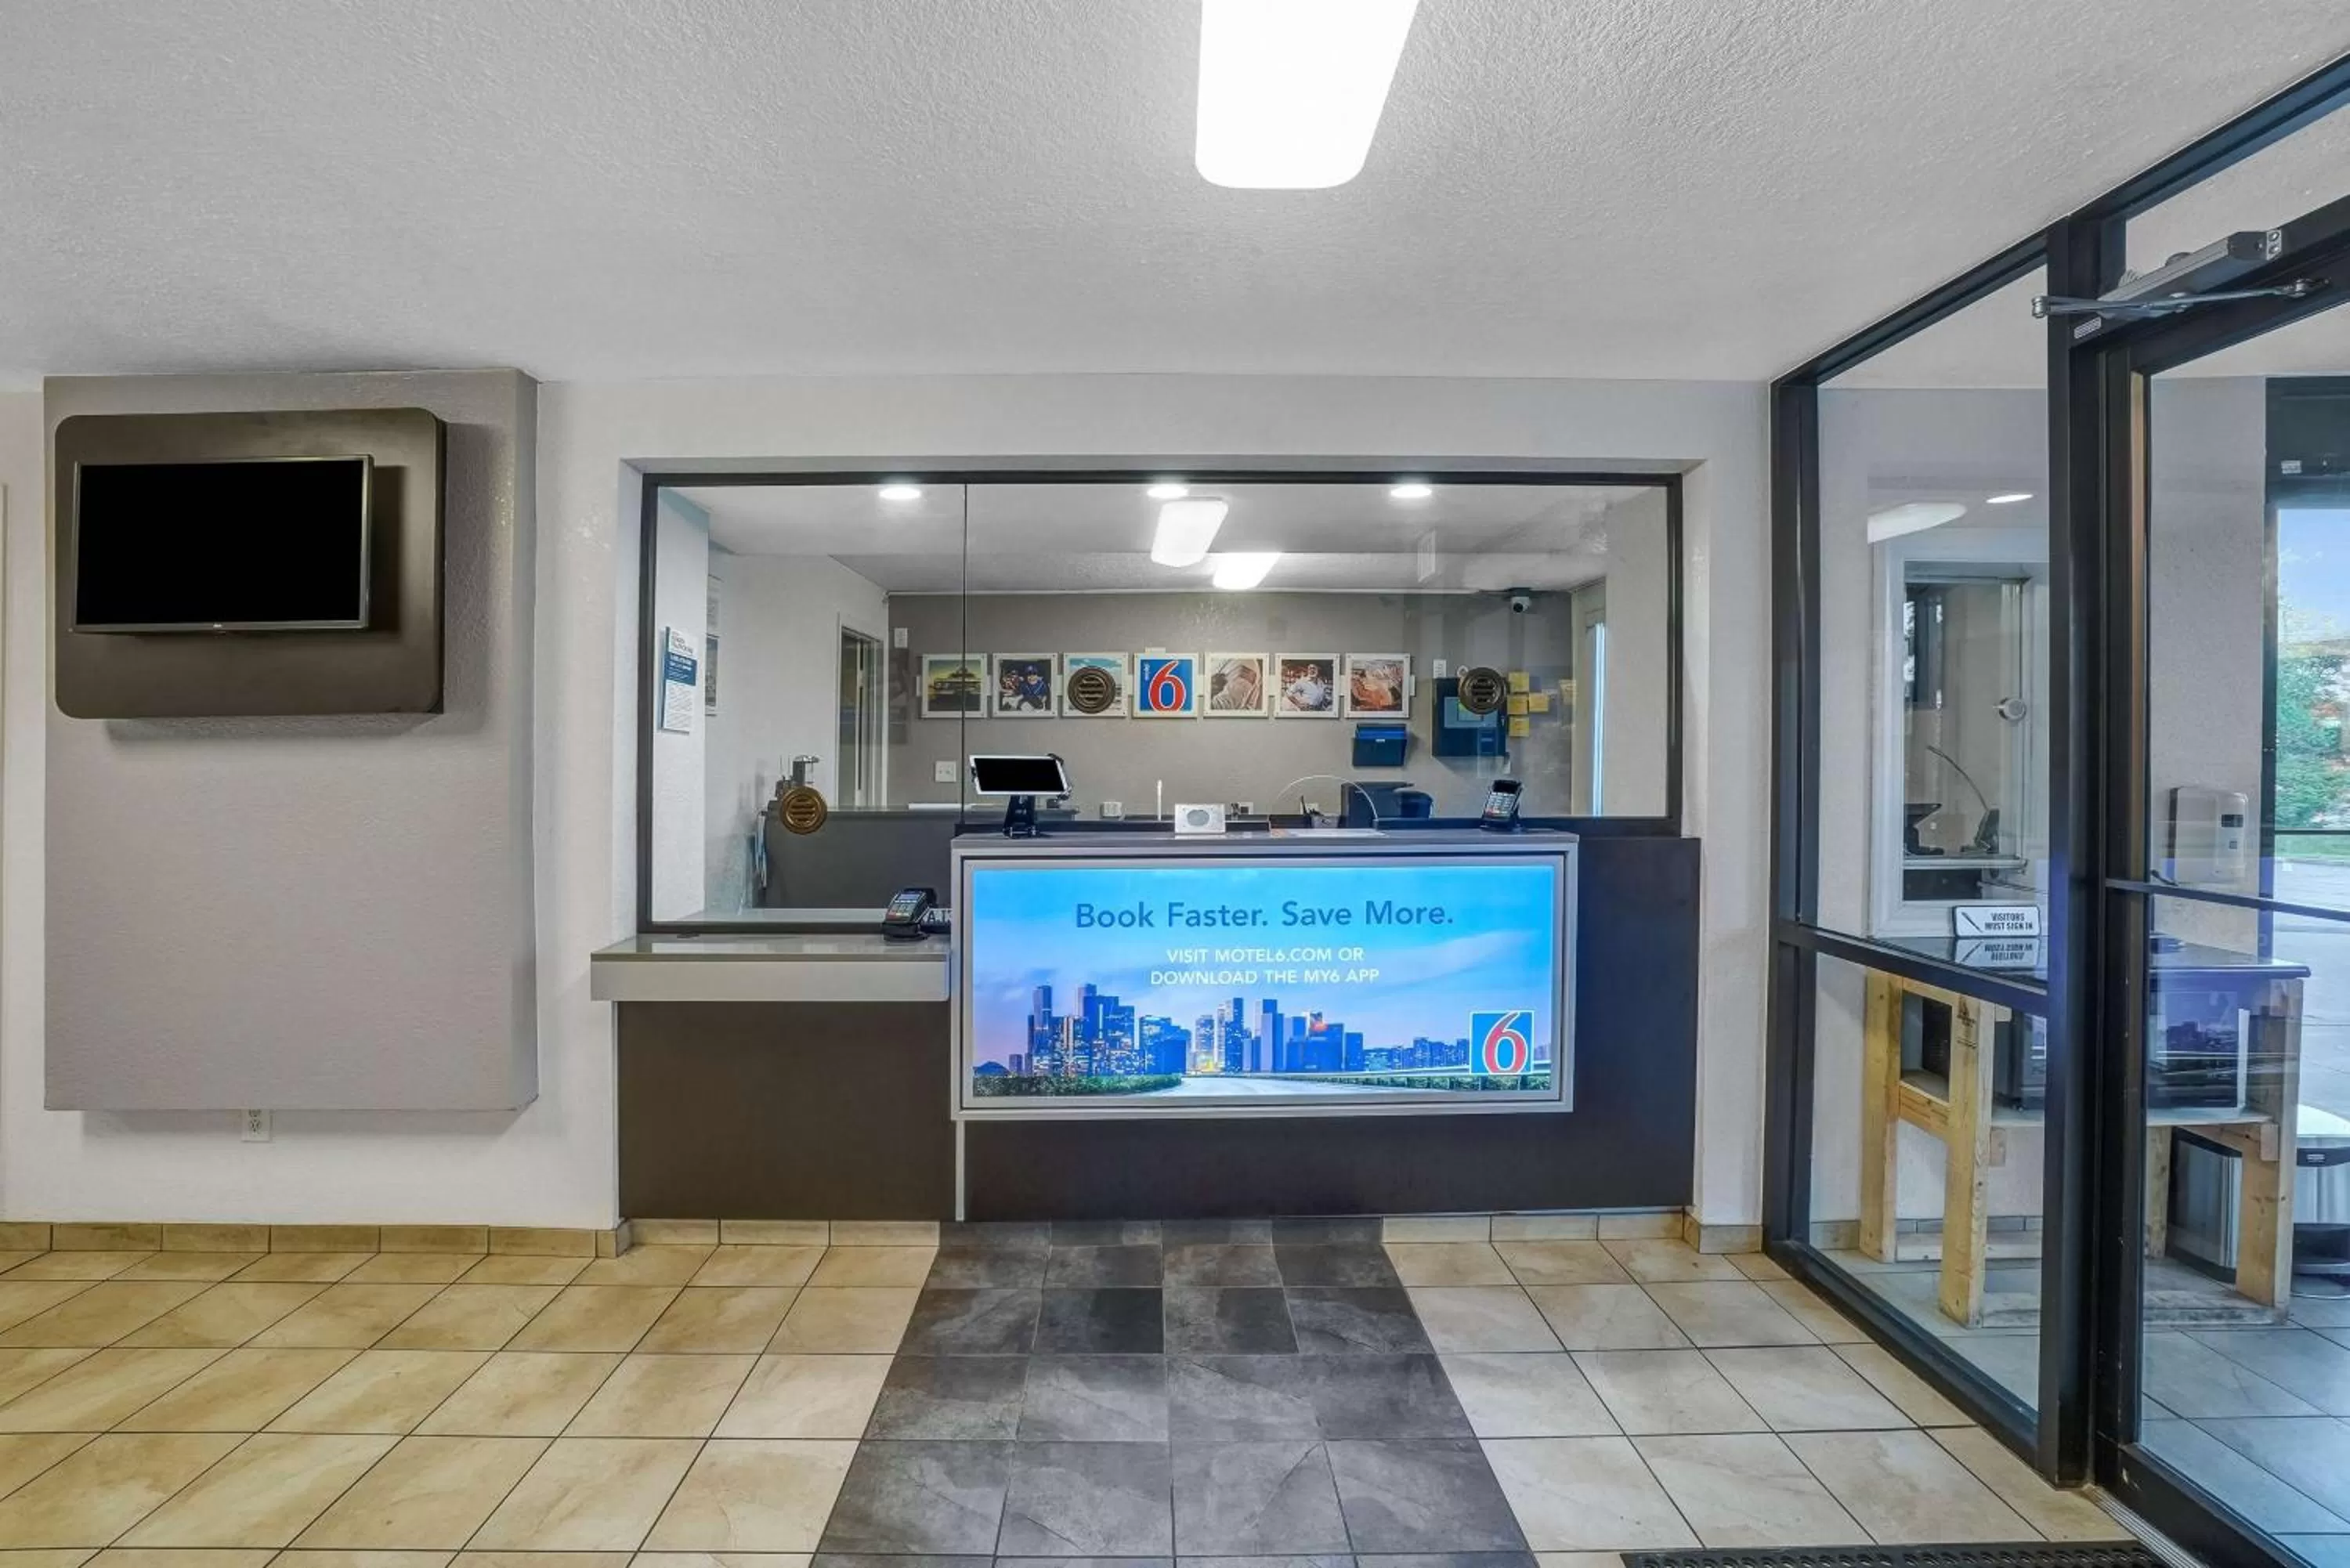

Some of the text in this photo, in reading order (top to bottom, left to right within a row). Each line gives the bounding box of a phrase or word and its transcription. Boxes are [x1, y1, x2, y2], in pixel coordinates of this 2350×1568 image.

[1148, 660, 1187, 712] 6
[1076, 900, 1454, 928] Book Faster. Save More.
[1990, 912, 2025, 922] VISITORS
[1166, 947, 1365, 963] VISIT MOTEL6.COM OR
[1151, 968, 1380, 985] DOWNLOAD THE MY6 APP
[1482, 1010, 1528, 1075] 6
